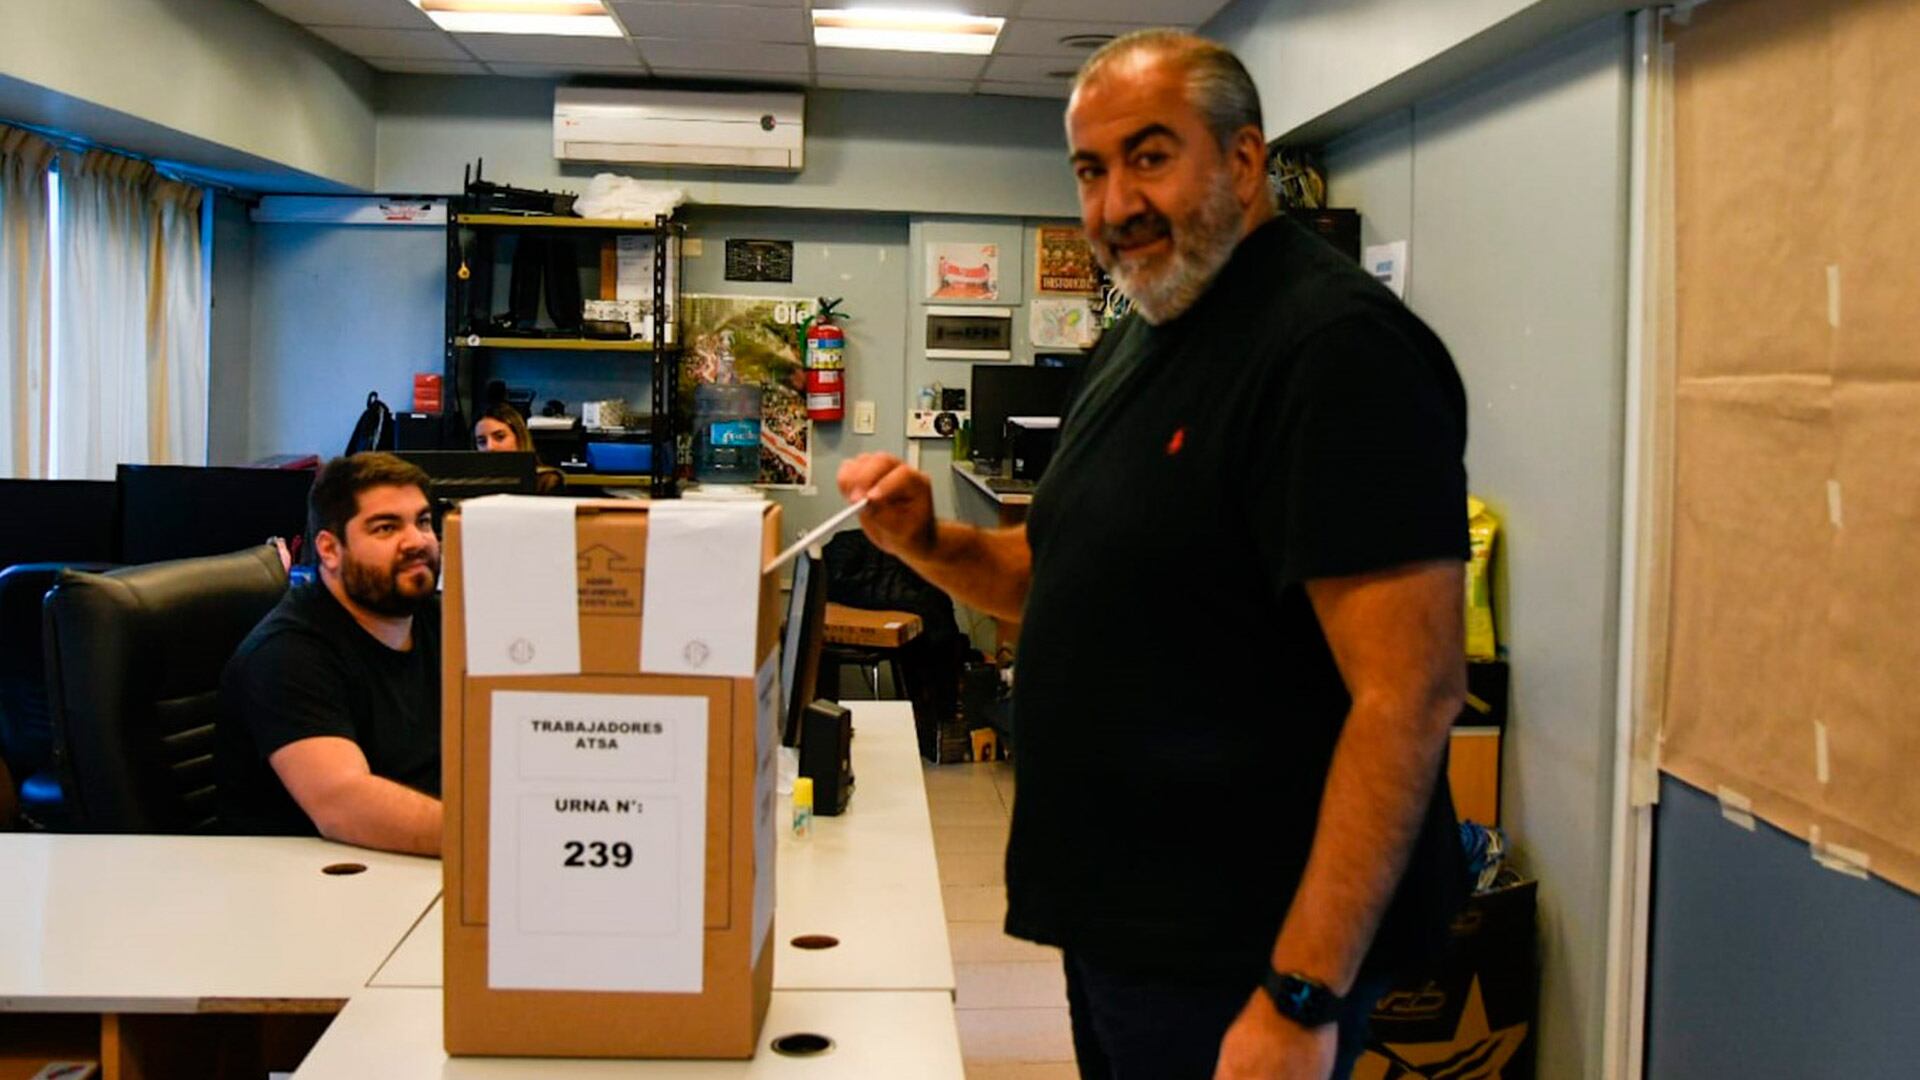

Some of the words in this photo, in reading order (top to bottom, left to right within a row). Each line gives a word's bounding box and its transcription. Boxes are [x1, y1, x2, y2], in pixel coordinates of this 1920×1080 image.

[531, 720, 663, 734] TRABAJADORES
[575, 738, 618, 749] ATSA
[555, 799, 610, 813] URNA
[563, 840, 634, 868] 239
